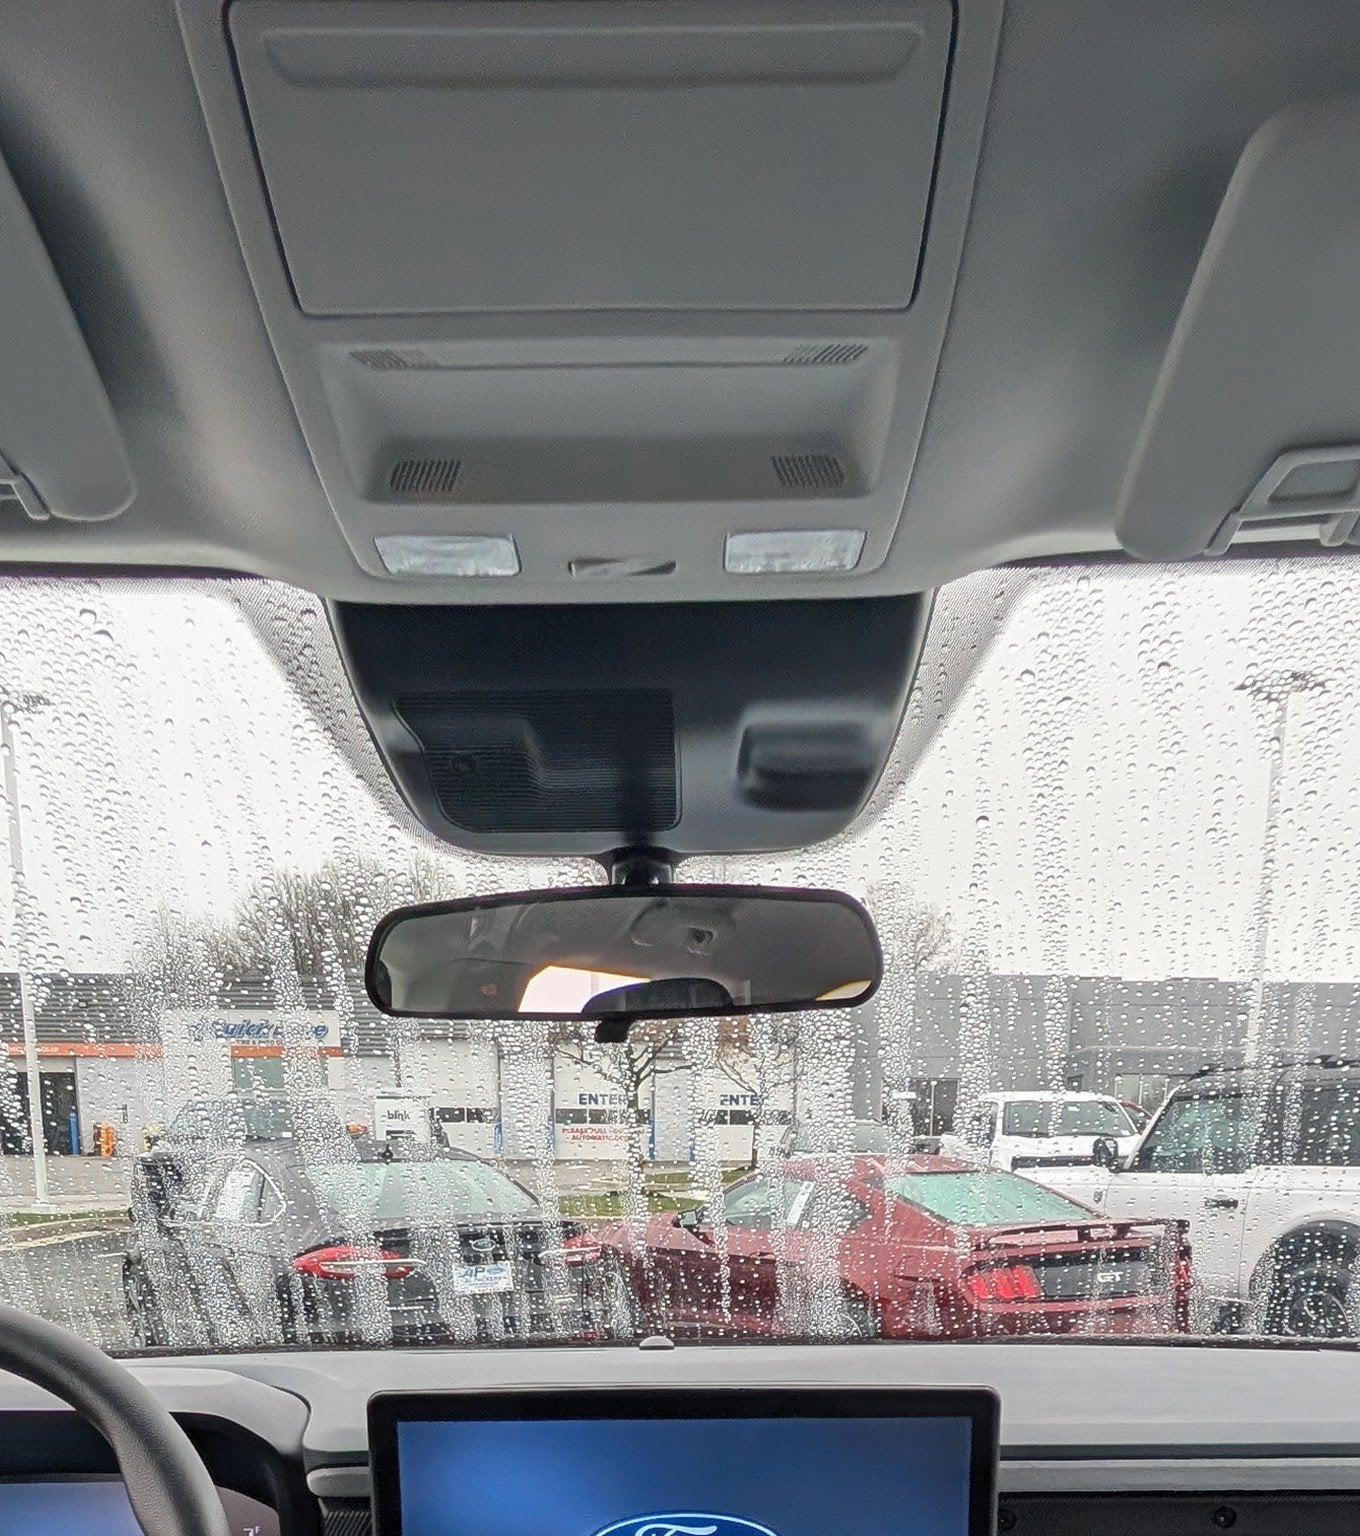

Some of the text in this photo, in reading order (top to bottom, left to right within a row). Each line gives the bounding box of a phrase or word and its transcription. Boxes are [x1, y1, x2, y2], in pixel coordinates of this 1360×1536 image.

[579, 1093, 628, 1105] ENTER
[386, 1110, 411, 1122] blink
[1097, 1271, 1124, 1283] GT
